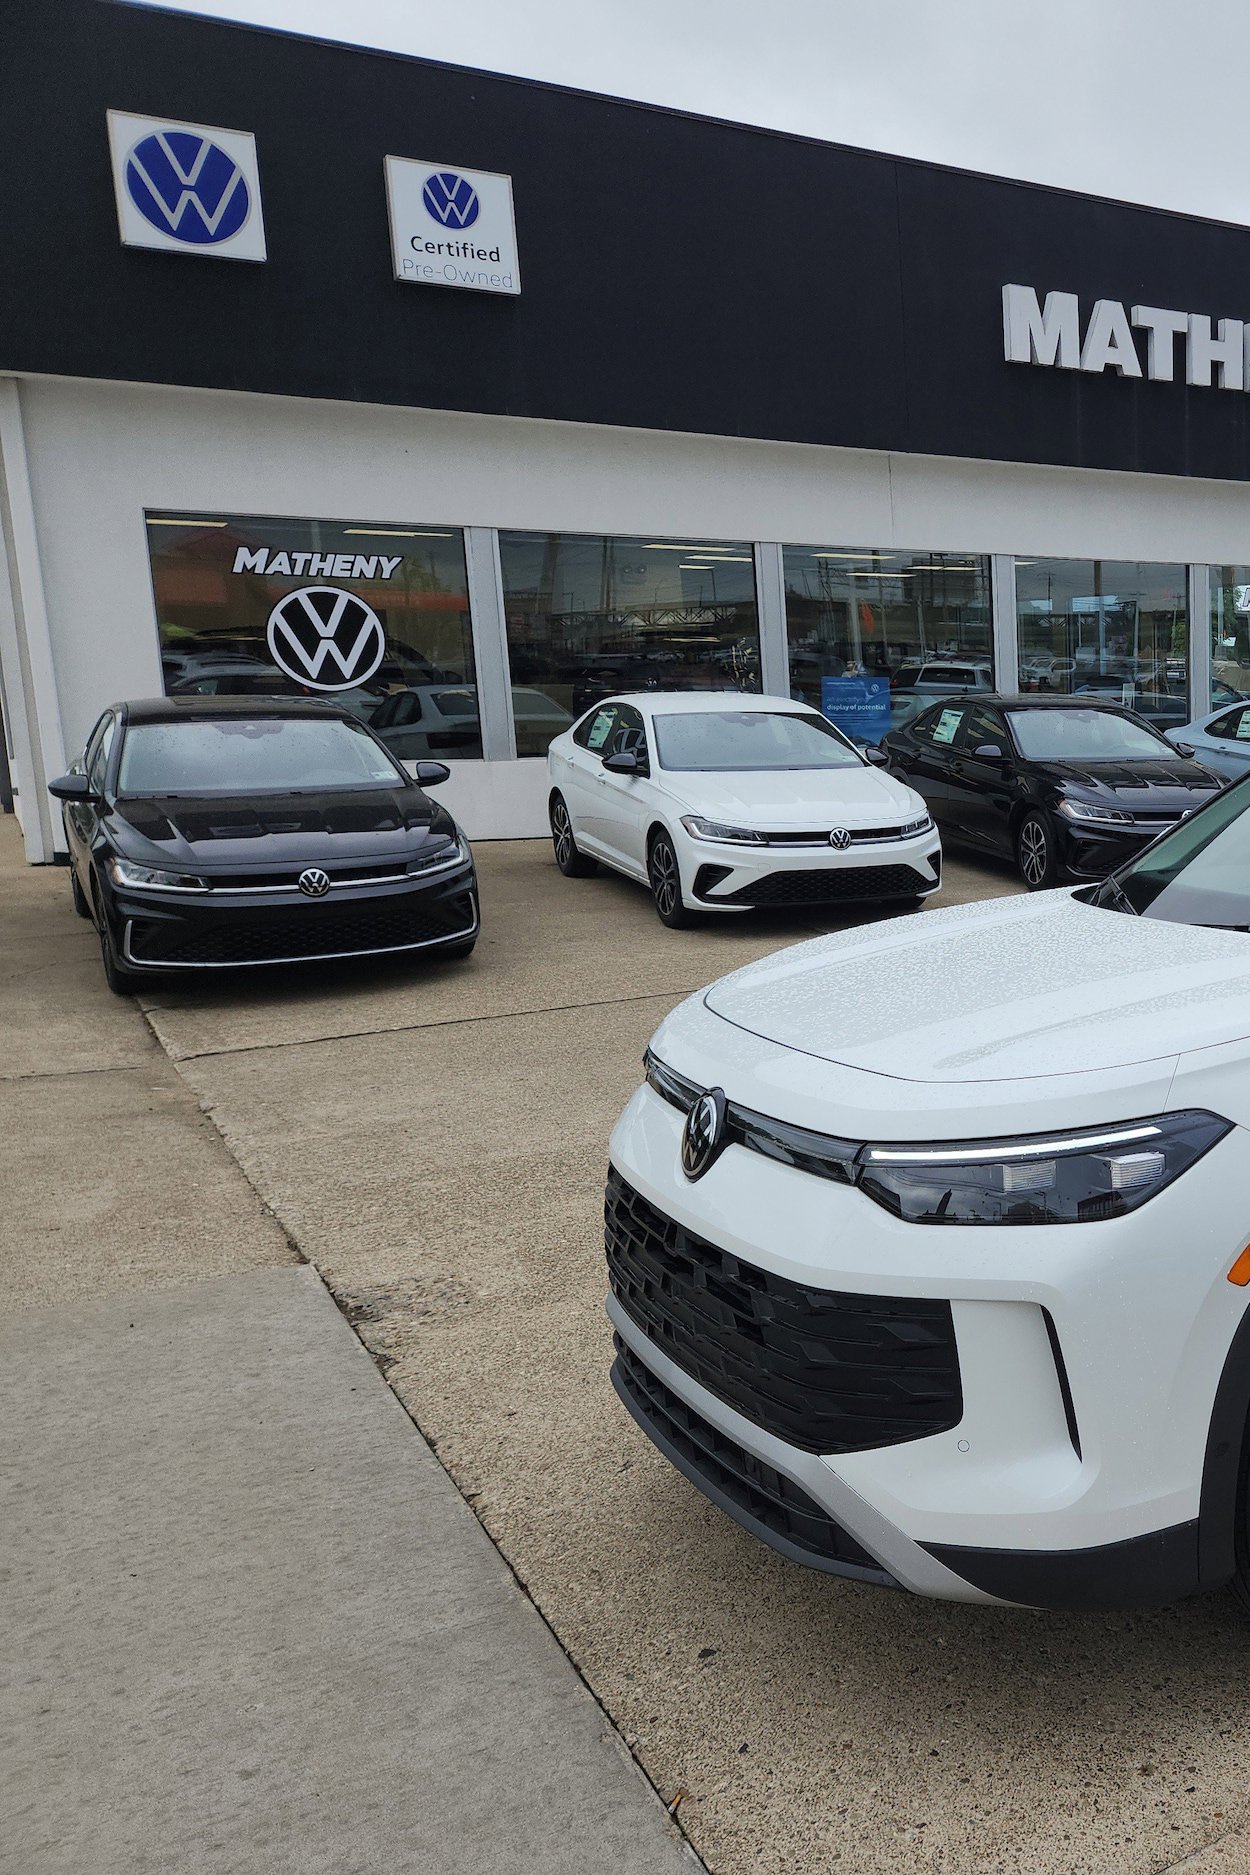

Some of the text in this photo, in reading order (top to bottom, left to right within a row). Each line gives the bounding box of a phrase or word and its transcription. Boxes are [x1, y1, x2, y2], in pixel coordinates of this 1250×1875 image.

[125, 129, 247, 240] VW
[423, 173, 478, 227] VW
[410, 236, 500, 262] Certified
[402, 259, 513, 288] Pre-Owned
[232, 546, 402, 579] MATHENY
[271, 589, 380, 683] VW
